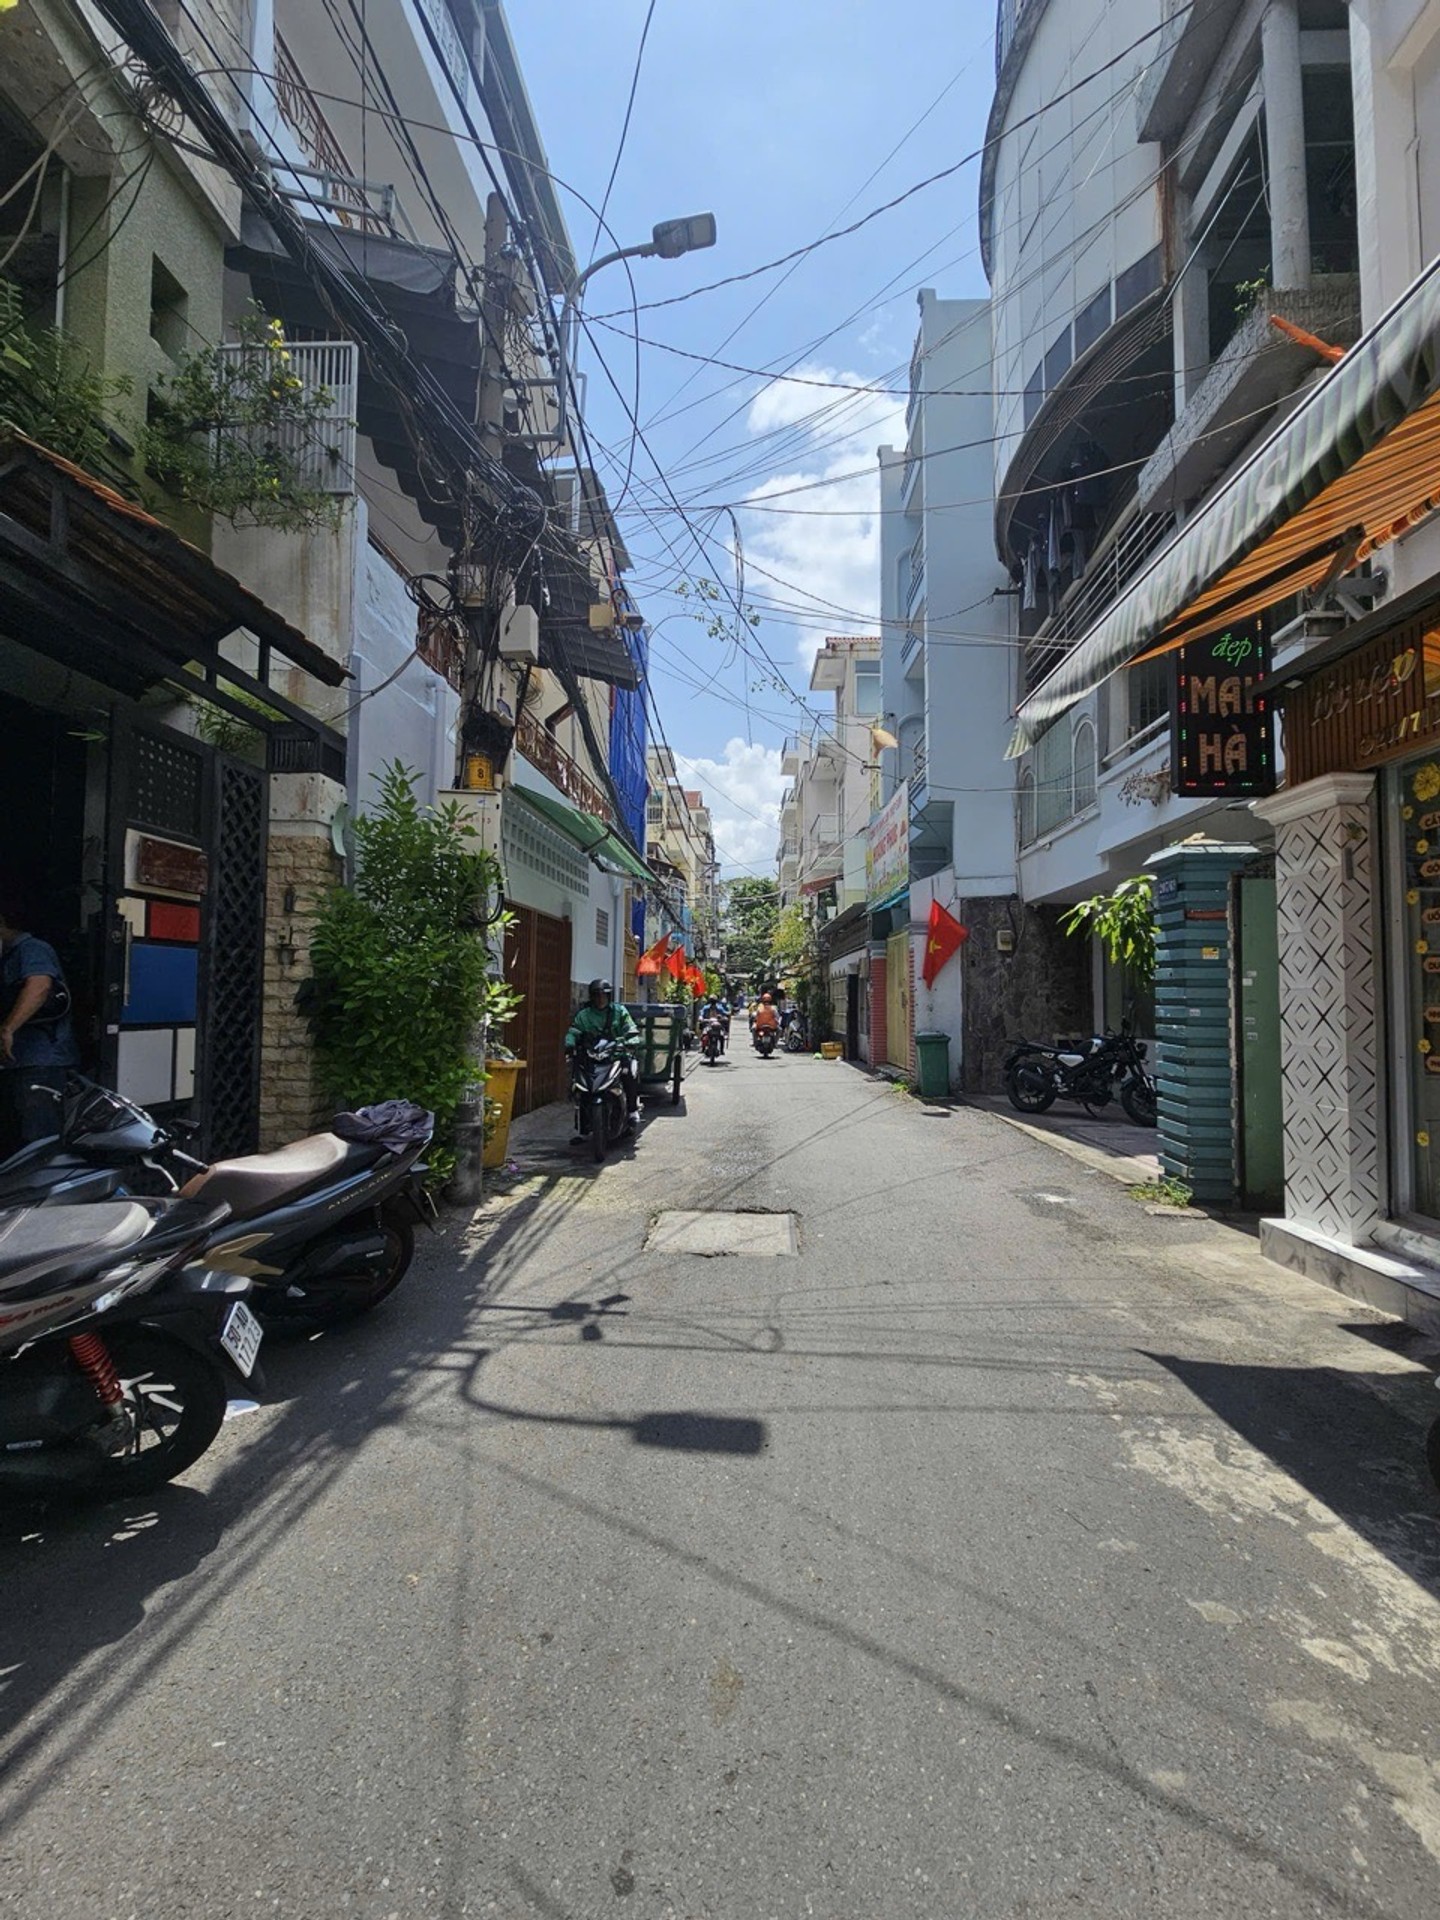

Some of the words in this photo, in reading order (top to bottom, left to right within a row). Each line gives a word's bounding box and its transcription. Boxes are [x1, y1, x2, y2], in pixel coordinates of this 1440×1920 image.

[1211, 632, 1252, 668] đẹp
[1190, 675, 1254, 719] MAI
[1198, 724, 1247, 776] HÀ
